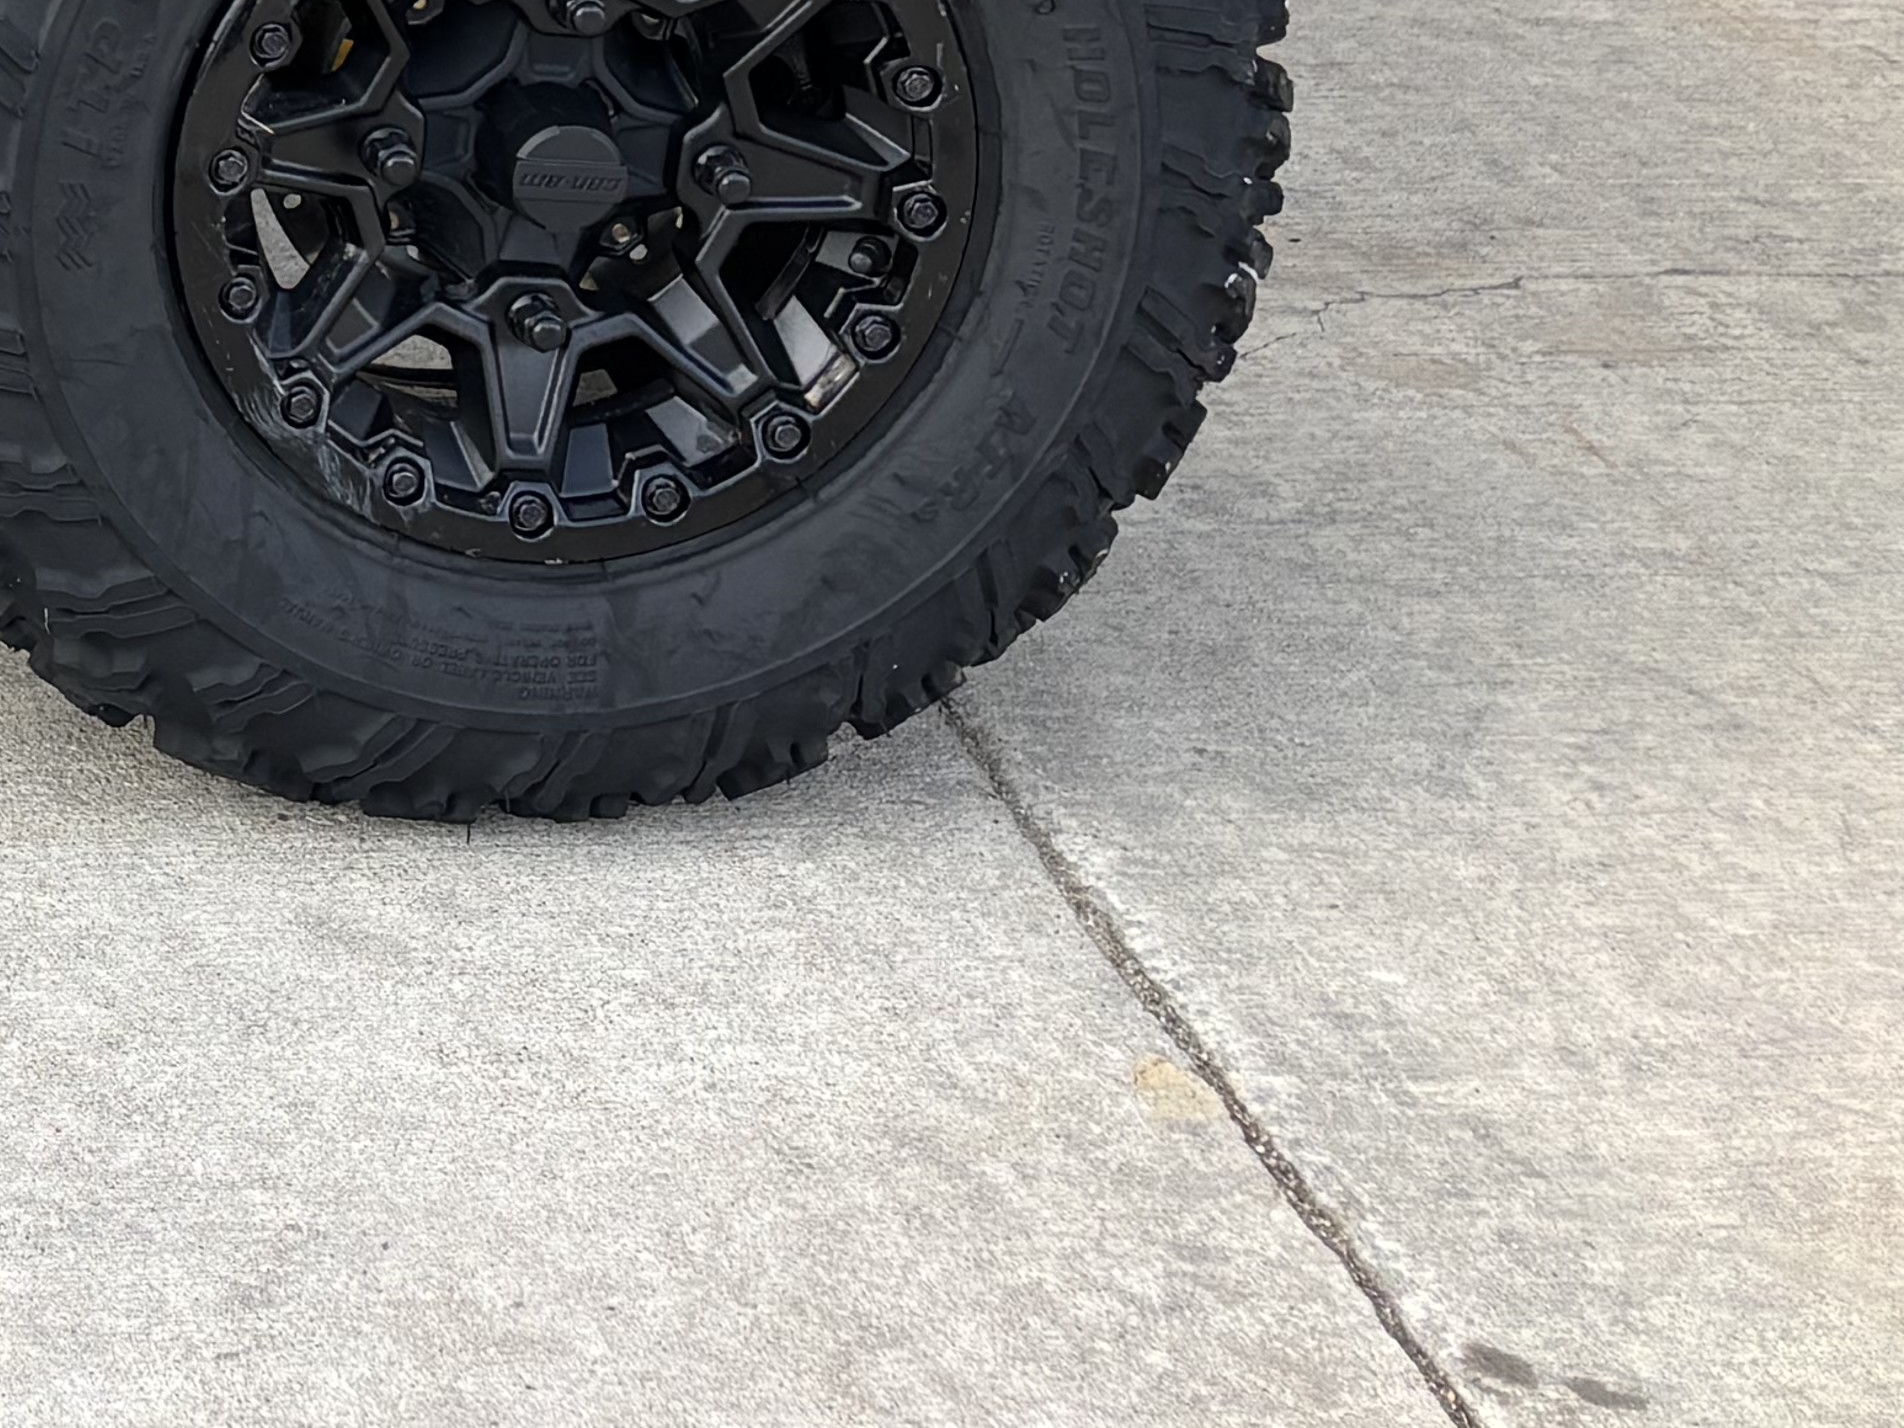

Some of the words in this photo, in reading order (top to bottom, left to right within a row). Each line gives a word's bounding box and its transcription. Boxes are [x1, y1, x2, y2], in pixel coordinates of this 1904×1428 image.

[518, 173, 623, 192] can-am
[1046, 26, 1117, 355] HOLESHOT
[517, 684, 598, 700] WARNING
